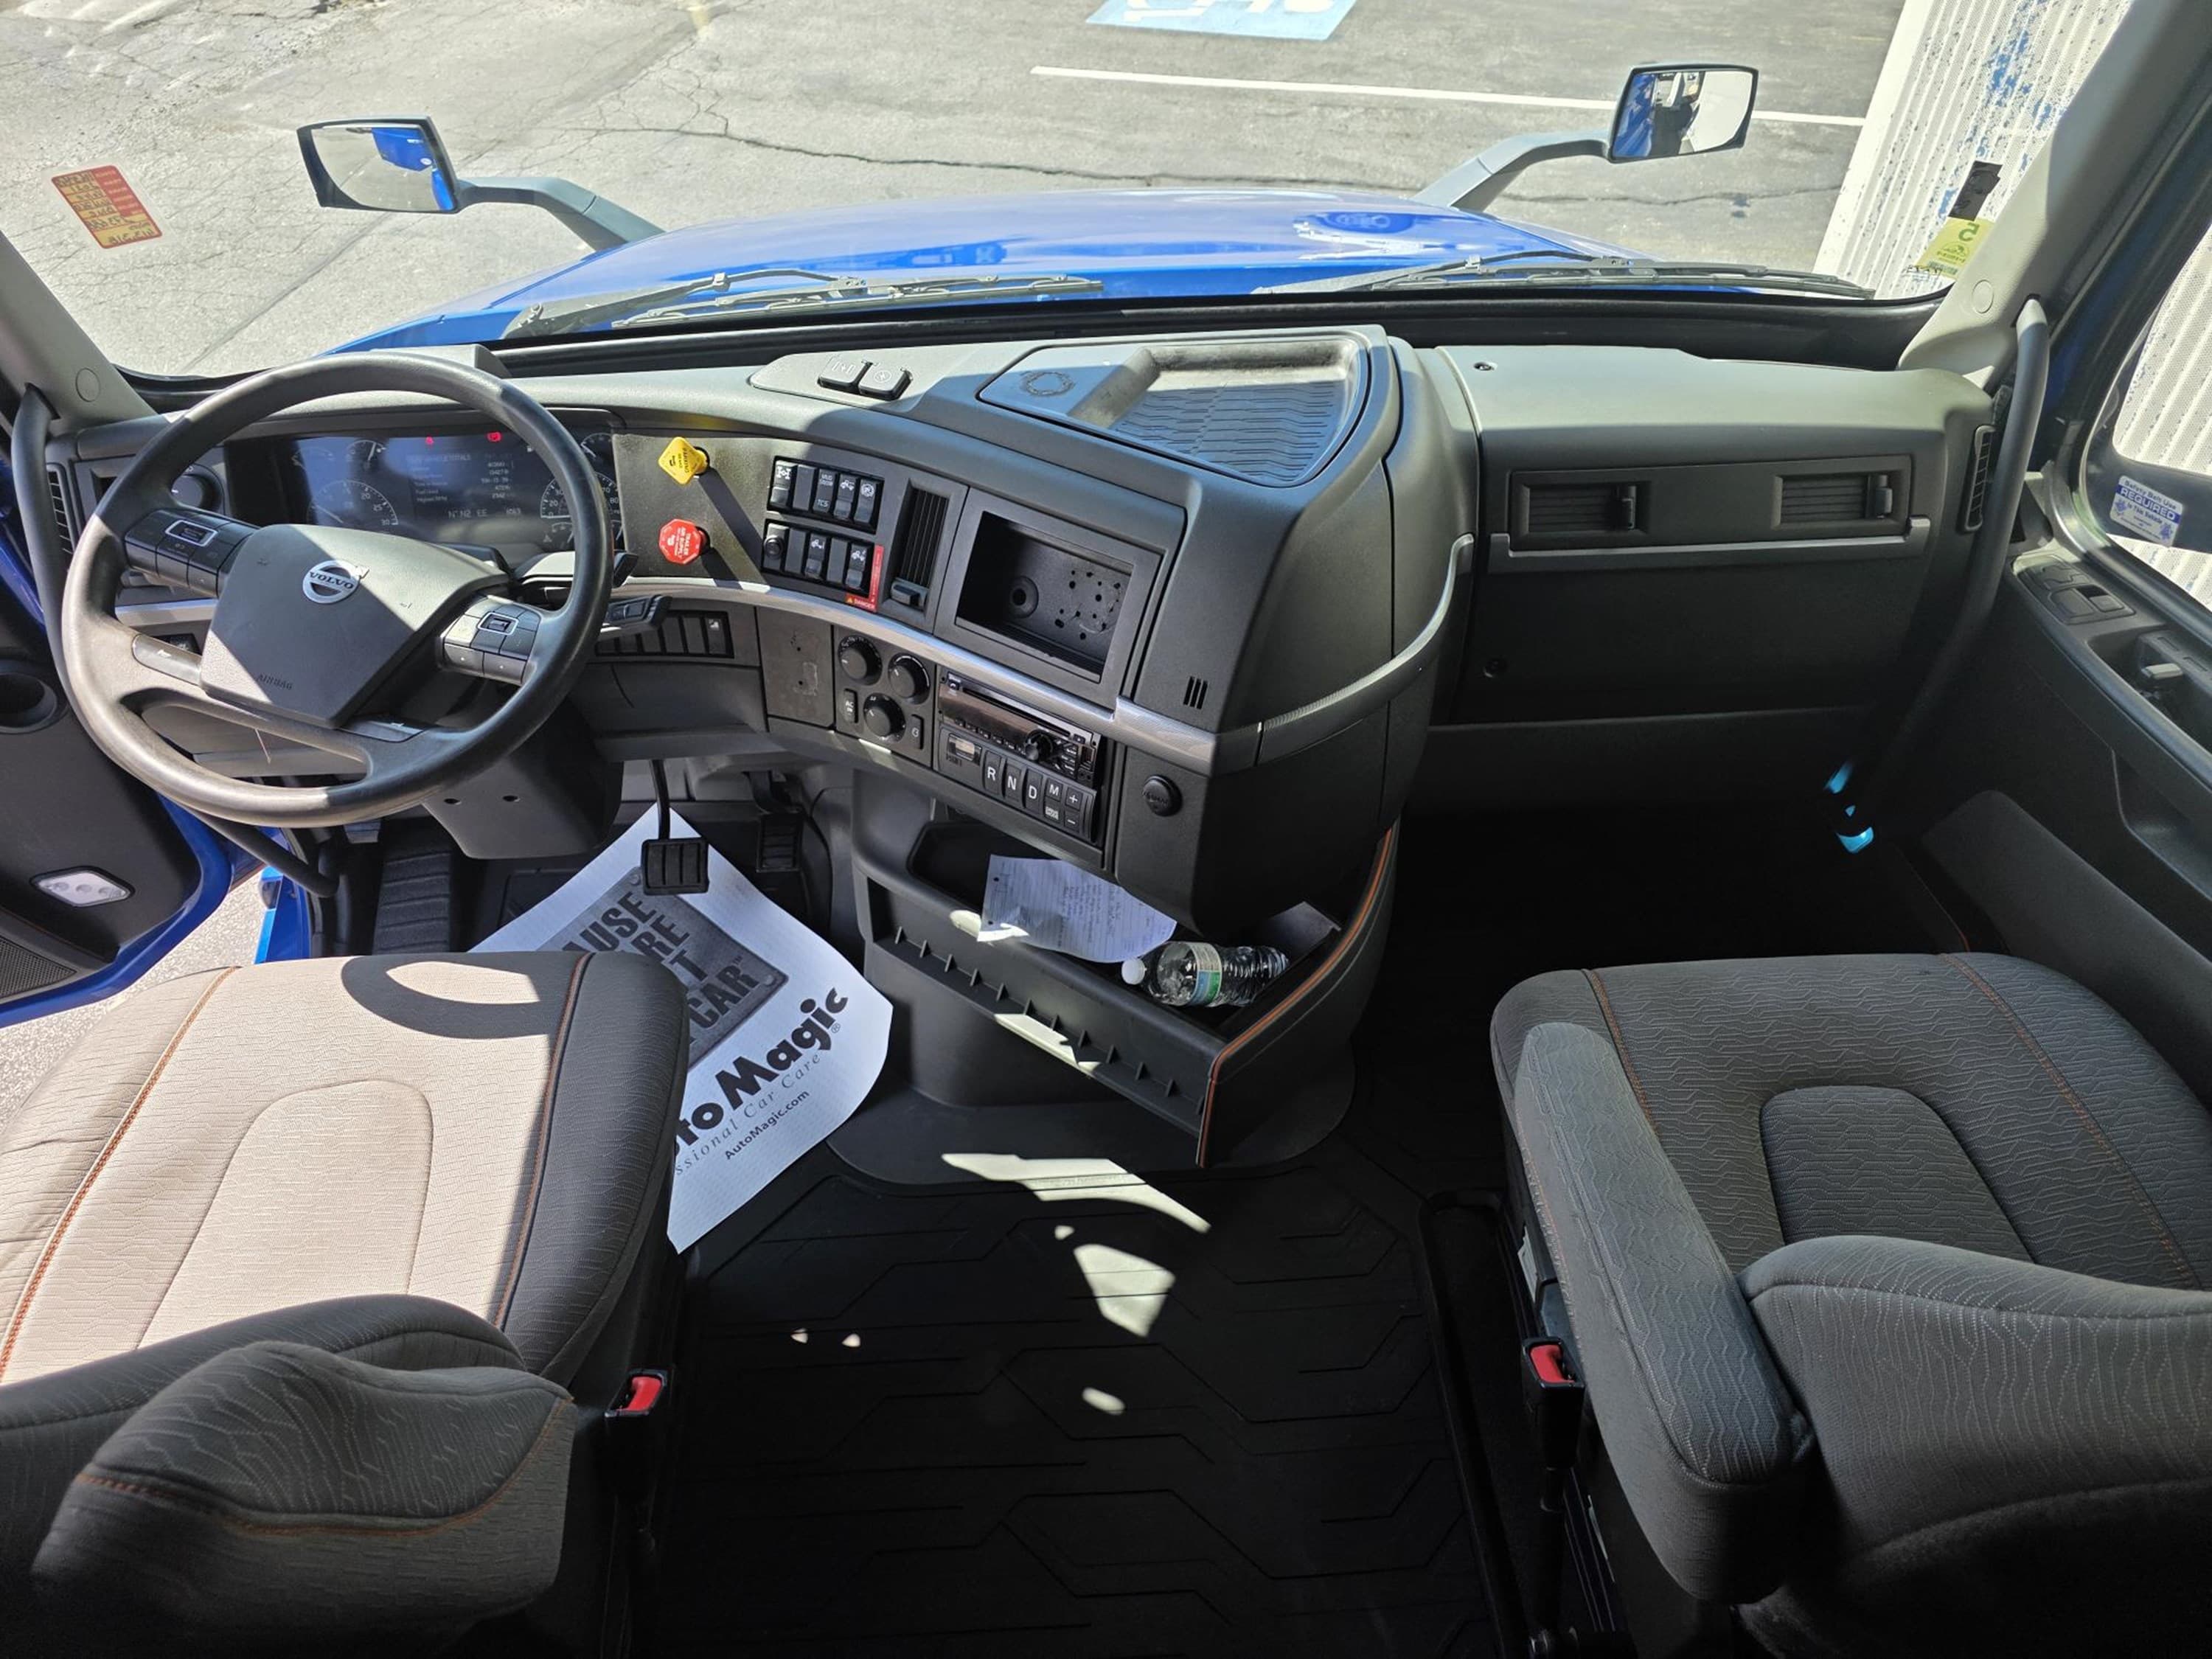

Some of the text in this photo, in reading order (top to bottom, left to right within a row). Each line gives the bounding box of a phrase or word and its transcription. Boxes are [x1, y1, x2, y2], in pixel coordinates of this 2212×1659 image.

[2120, 487, 2176, 520] REQUIRED
[310, 571, 355, 589] VOLVO
[987, 766, 996, 782] R
[1007, 776, 1017, 791] N
[1028, 785, 1037, 800] D
[1049, 783, 1060, 796] M
[562, 892, 657, 952] USE
[675, 987, 849, 1157] to Magic
[743, 1090, 775, 1119] Car
[781, 1054, 821, 1089] Care
[725, 1090, 811, 1161] AutoMagic.com
